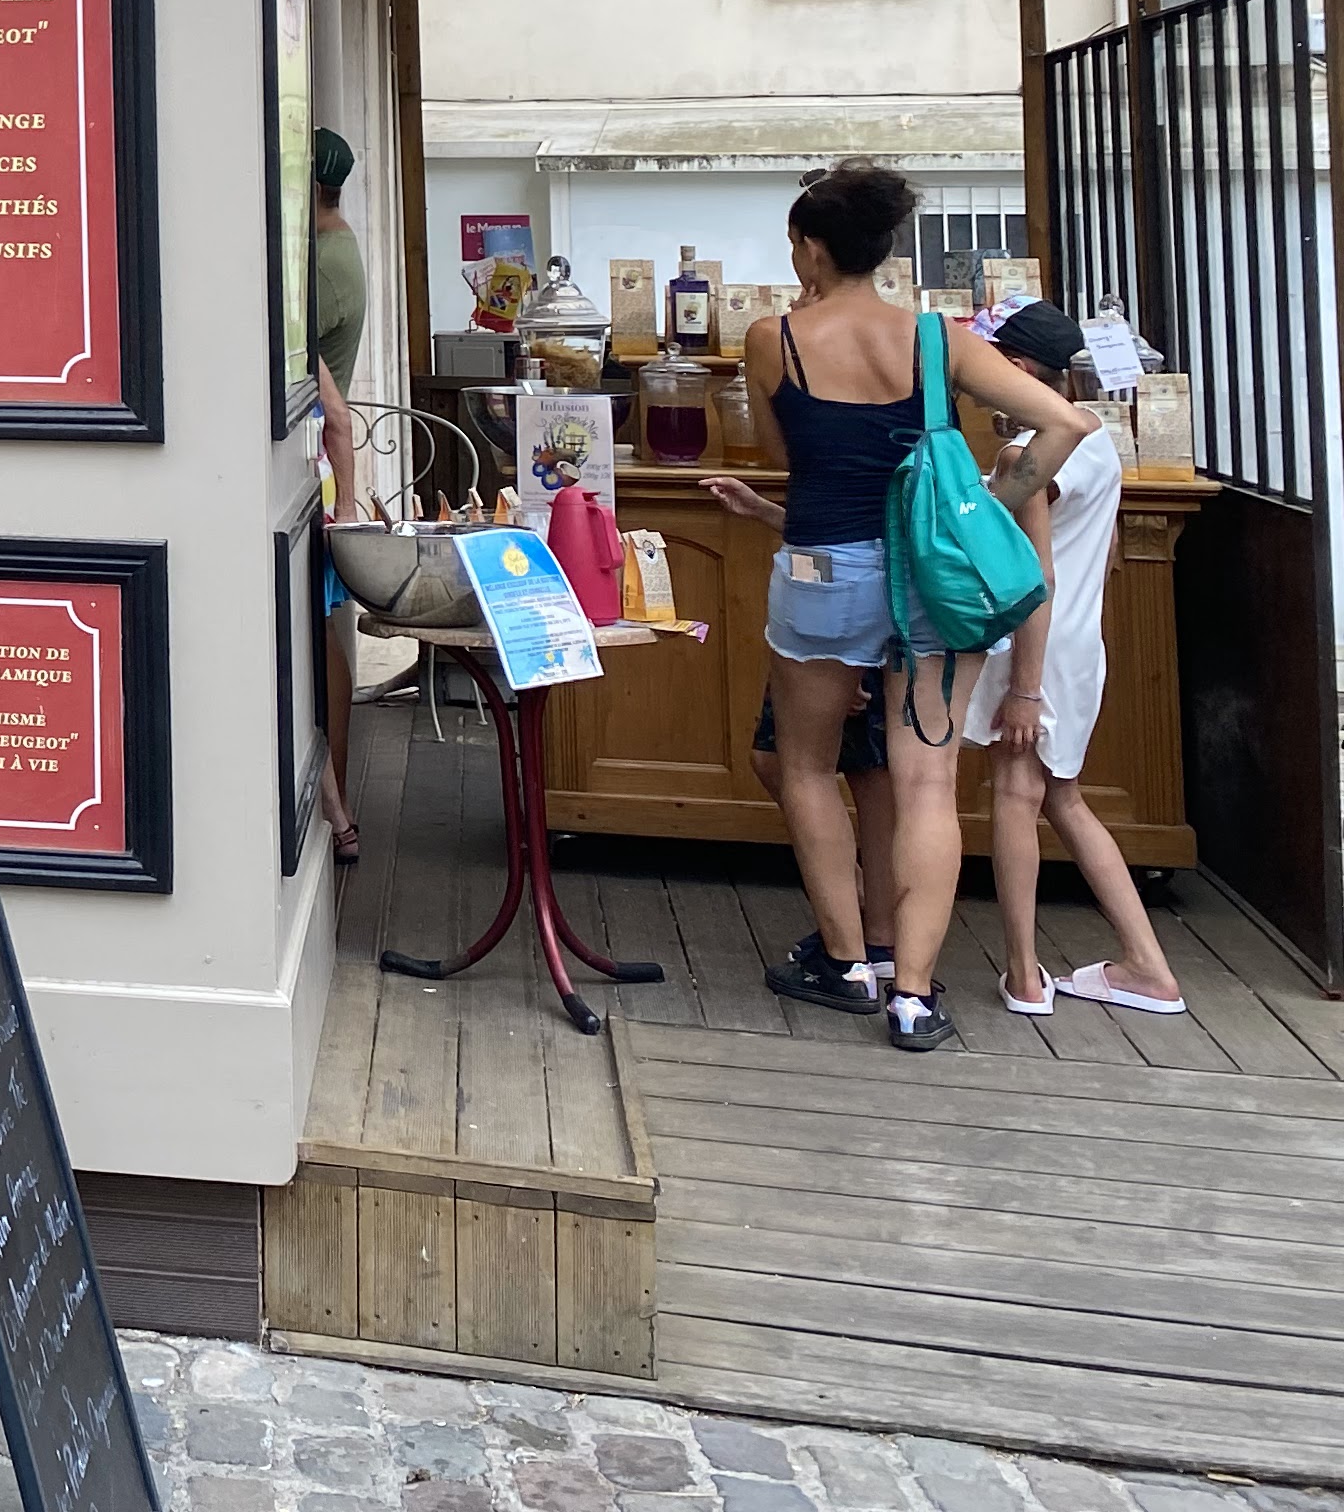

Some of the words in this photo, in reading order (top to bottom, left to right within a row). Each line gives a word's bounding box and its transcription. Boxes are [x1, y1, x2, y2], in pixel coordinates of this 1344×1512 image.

[540, 400, 590, 412] Infusion
[45, 647, 70, 661] DE
[10, 753, 23, 770] À
[28, 758, 59, 772] VIE
